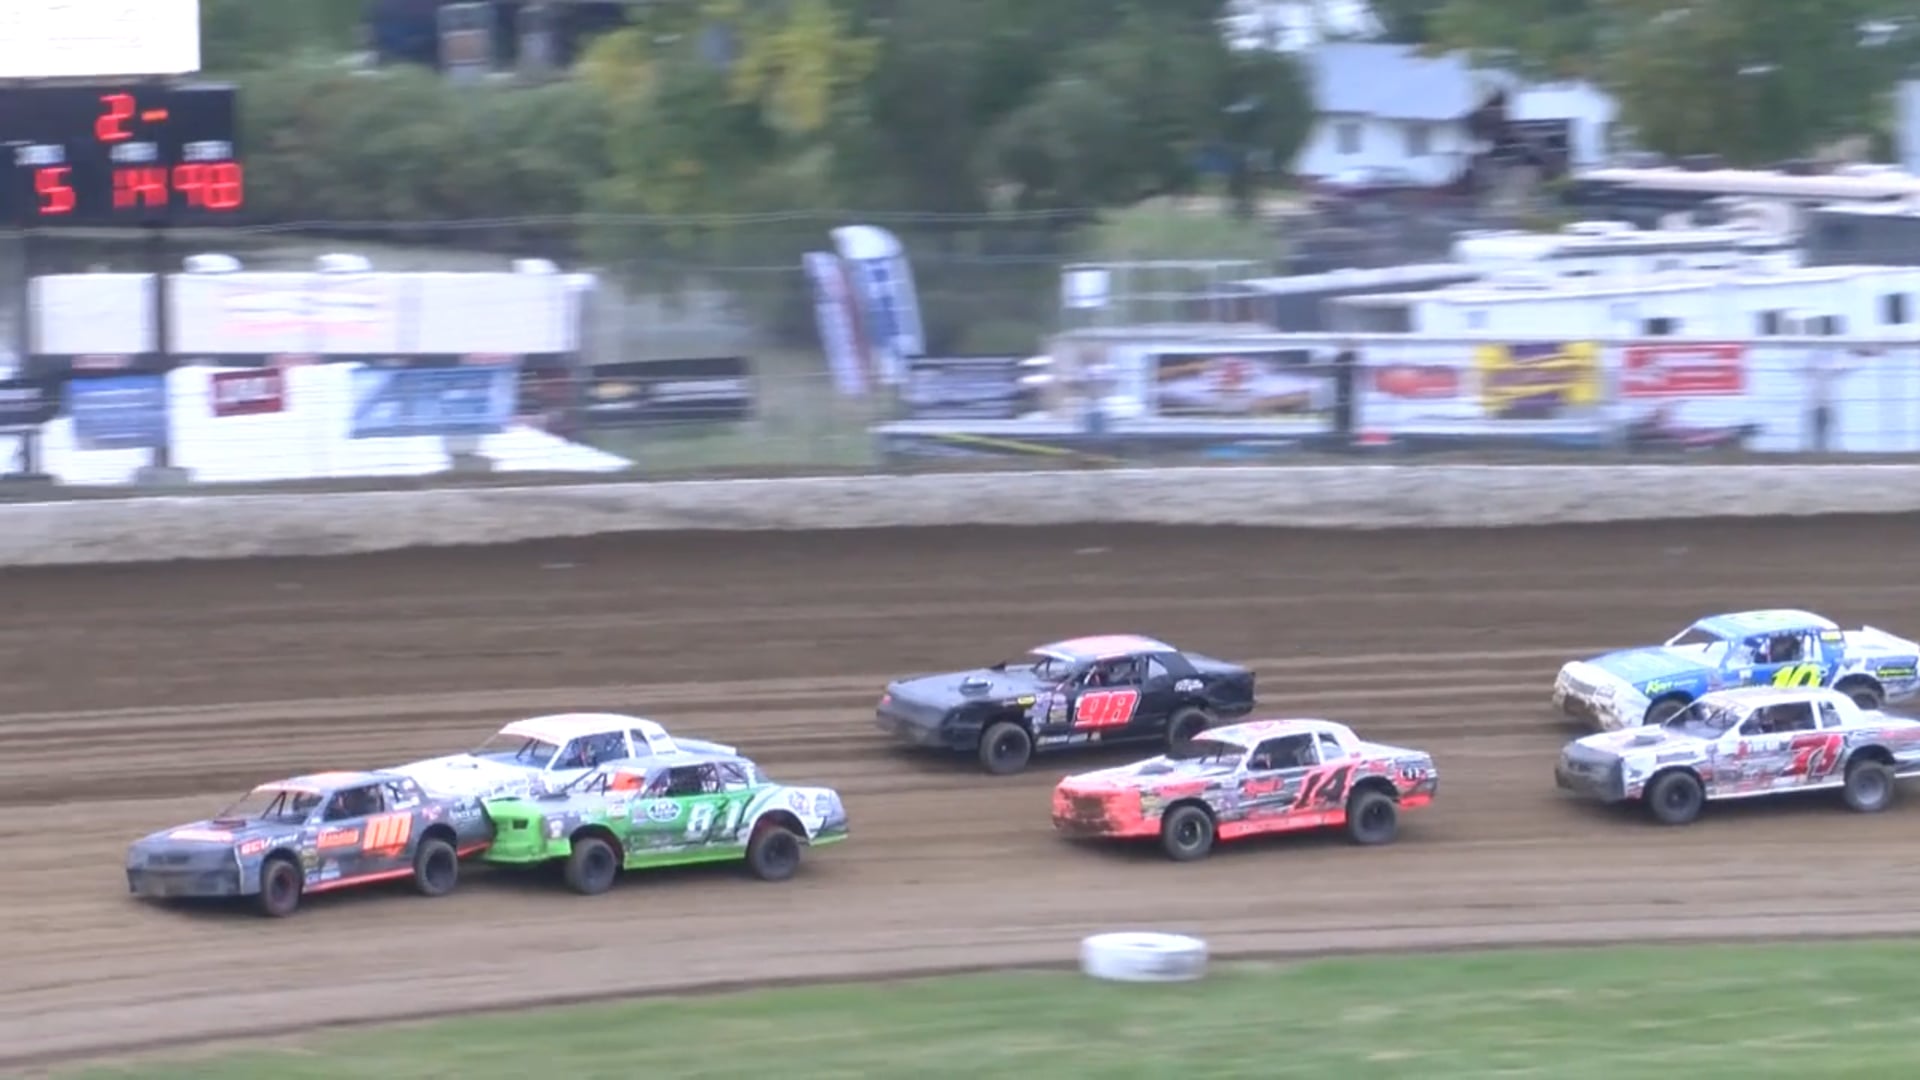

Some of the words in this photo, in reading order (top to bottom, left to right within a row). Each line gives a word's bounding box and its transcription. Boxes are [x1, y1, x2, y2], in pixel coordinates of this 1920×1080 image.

[35, 166, 75, 214] 5
[112, 167, 168, 208] 14
[173, 163, 243, 209] 98
[1772, 664, 1822, 689] 10
[1074, 689, 1139, 729] 98
[1291, 763, 1357, 811] 14
